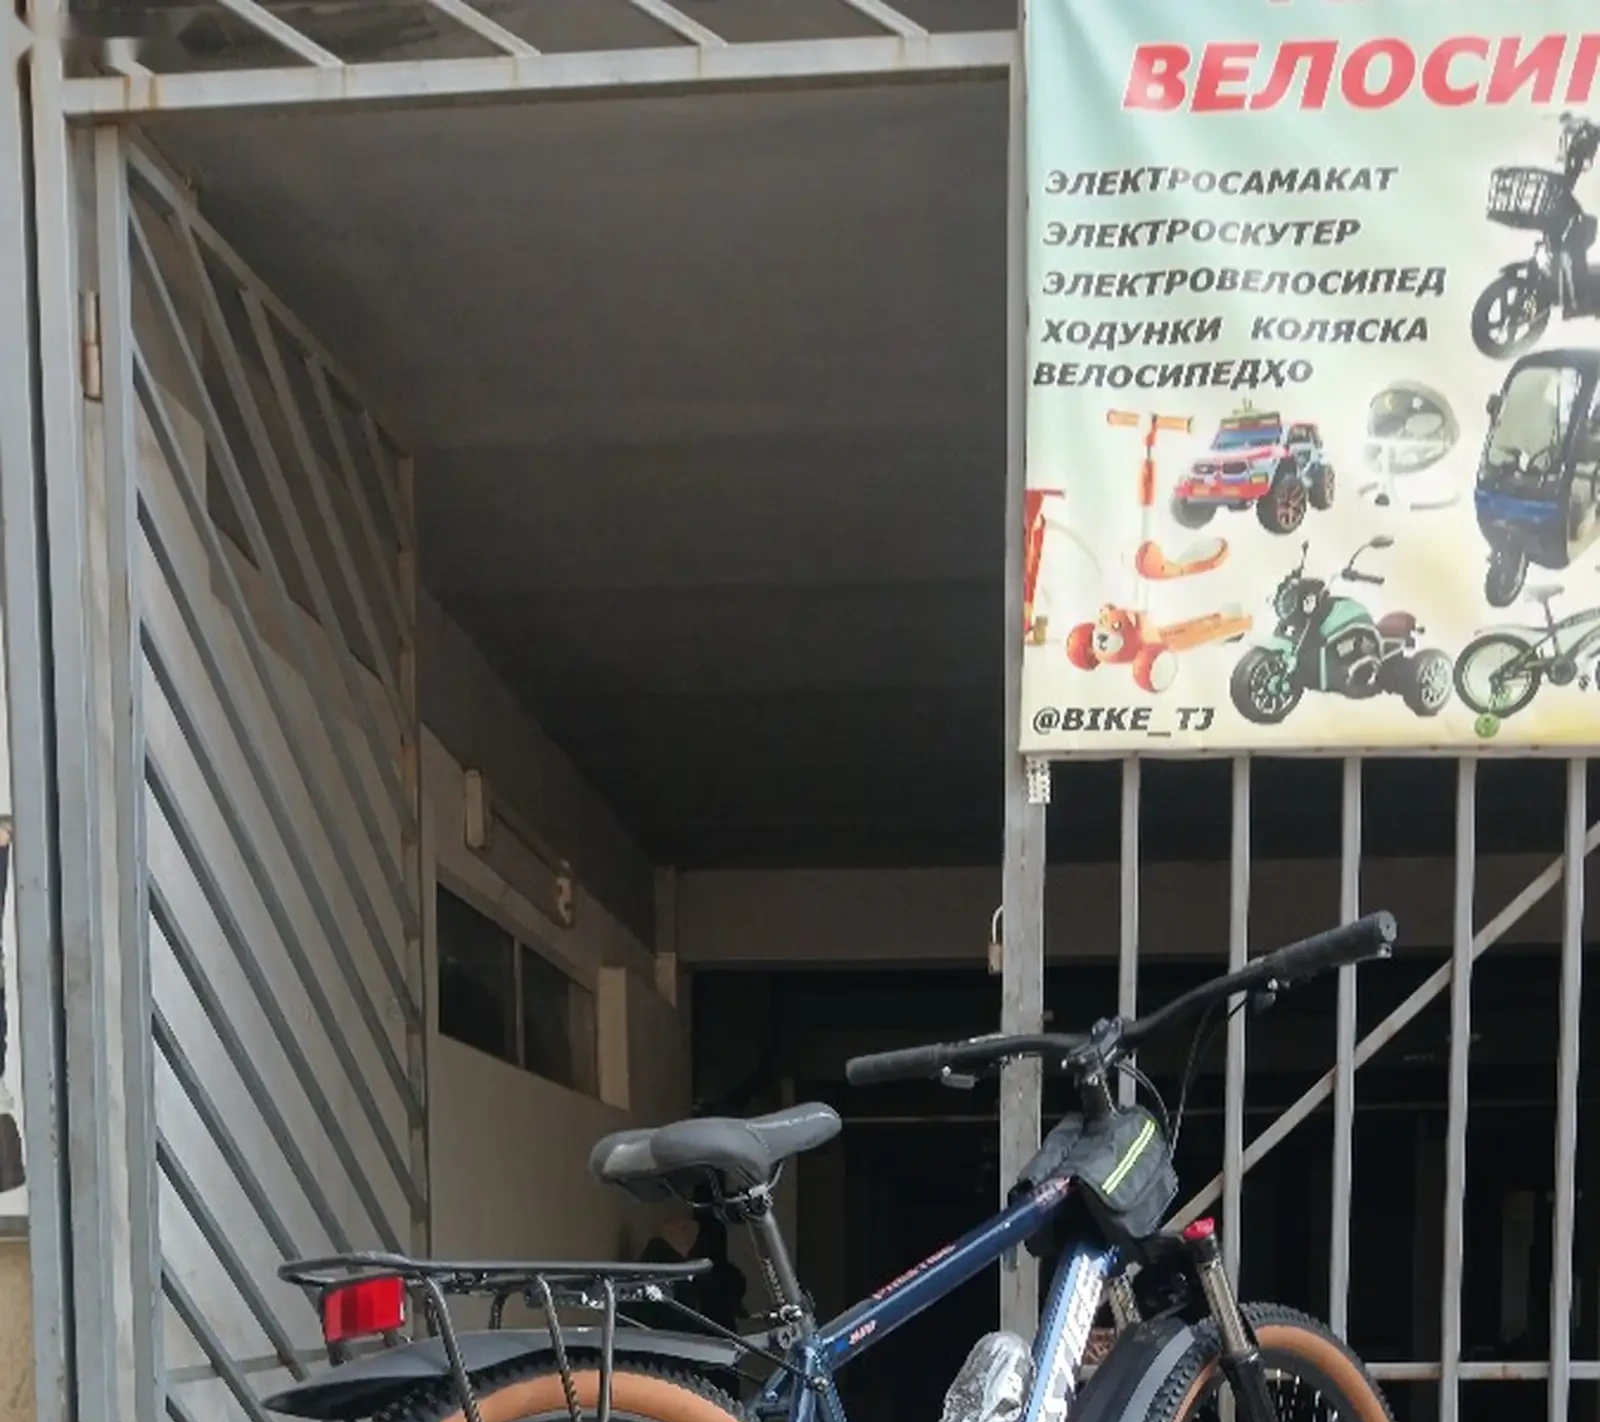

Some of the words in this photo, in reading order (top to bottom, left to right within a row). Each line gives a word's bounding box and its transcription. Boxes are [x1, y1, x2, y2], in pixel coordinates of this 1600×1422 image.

[1045, 166, 1398, 196] ЭЛЕКТРОСАМАКАТ
[1043, 219, 1361, 248] ЭЛЕКТРОСКУТЕР
[1043, 267, 1446, 298] ЭЛЕКТРОВЕЛОСИПЕД
[1041, 317, 1222, 350] ХОДУНКИ
[1251, 317, 1428, 342] КОЛЯСКА
[1033, 706, 1215, 737] @BIKE_TJ
